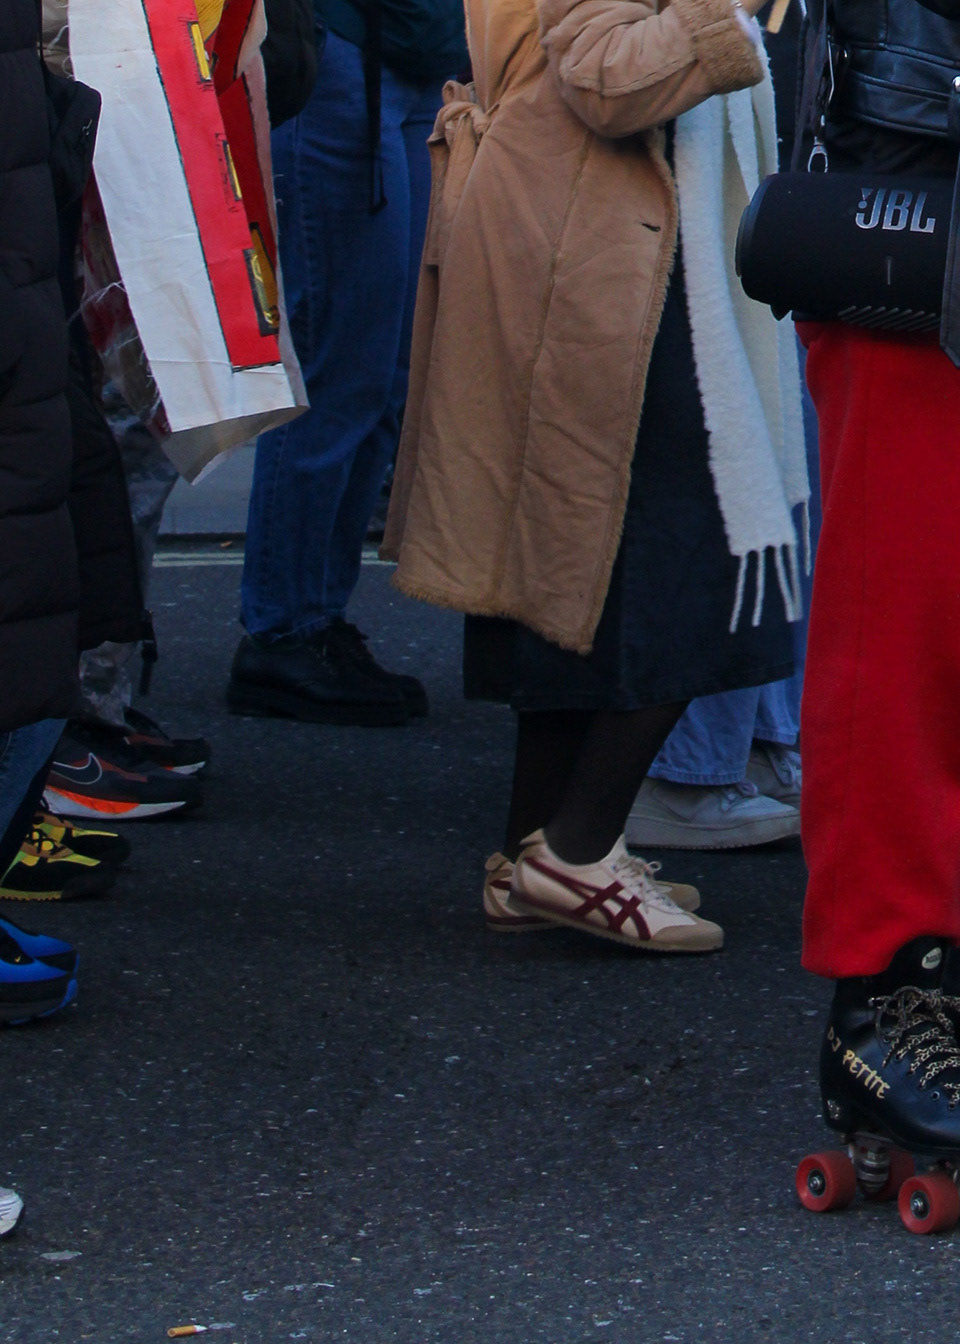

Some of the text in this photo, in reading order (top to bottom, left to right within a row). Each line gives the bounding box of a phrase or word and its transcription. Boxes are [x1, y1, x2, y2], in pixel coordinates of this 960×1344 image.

[855, 188, 936, 234] JBL
[827, 1026, 891, 1100] DJ PETITE
